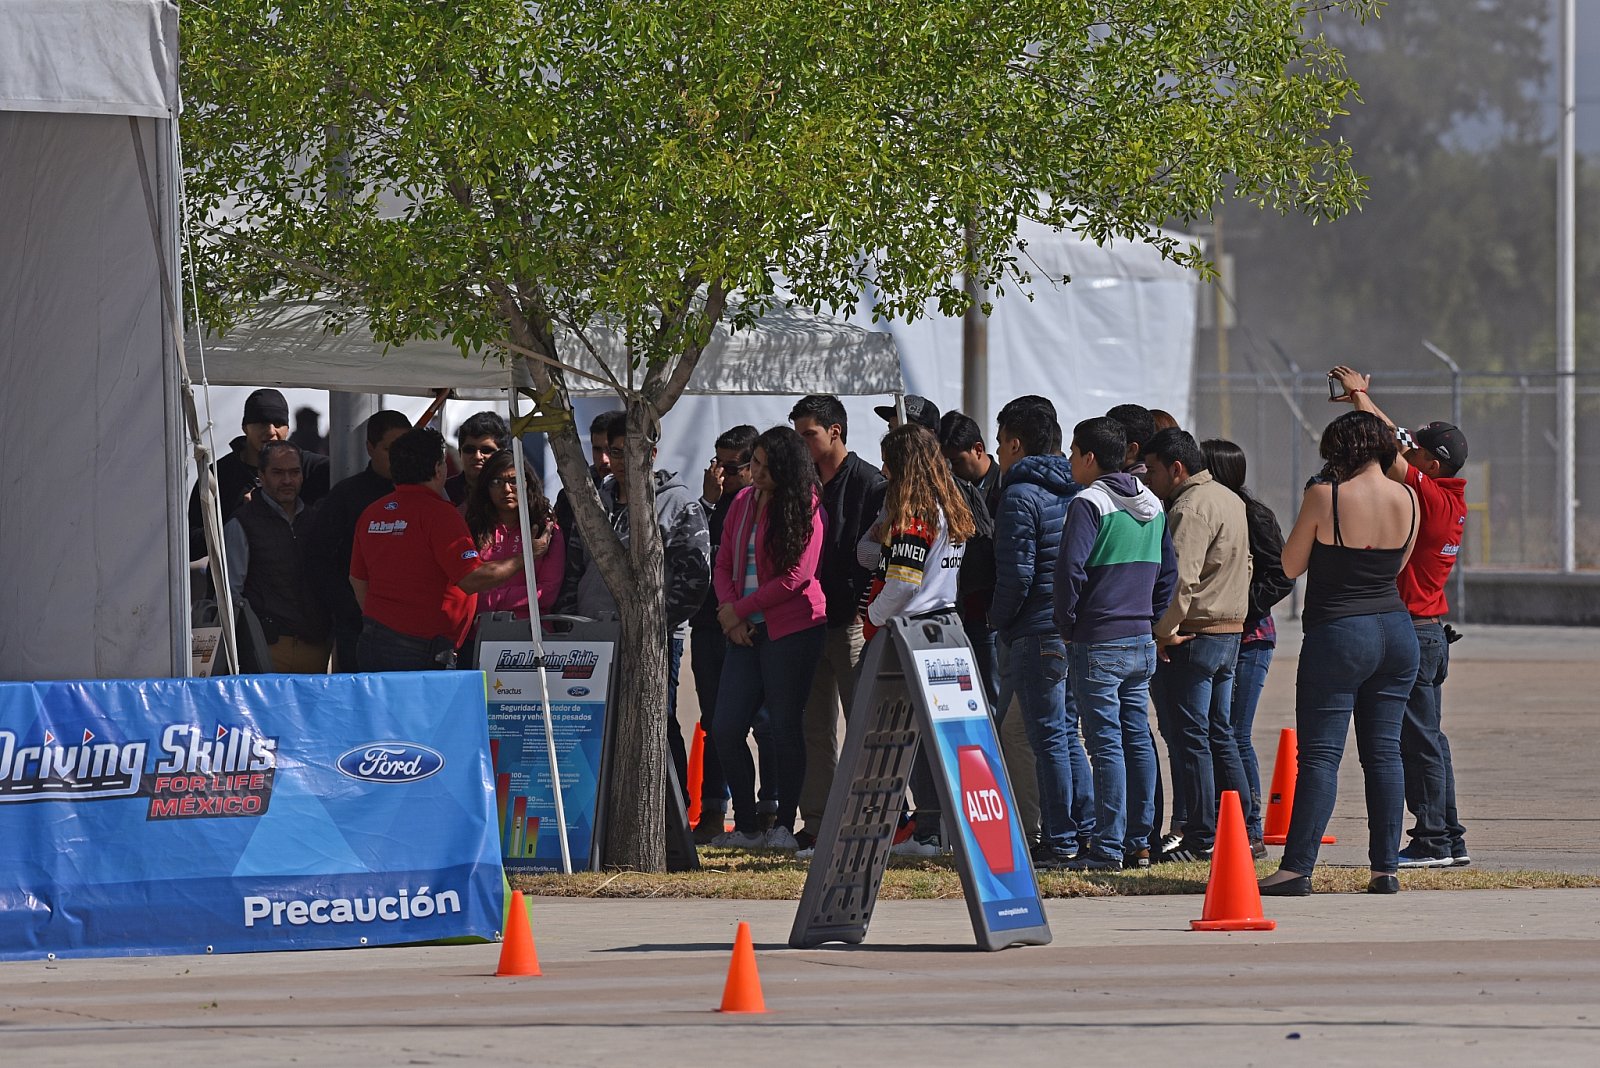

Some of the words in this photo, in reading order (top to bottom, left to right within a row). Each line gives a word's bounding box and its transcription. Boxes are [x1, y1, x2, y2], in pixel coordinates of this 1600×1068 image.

[568, 650, 599, 666] Skills
[500, 704, 536, 713] Seguridad
[572, 704, 581, 712] de
[158, 724, 276, 774] Skills
[359, 747, 422, 777] Ford
[155, 776, 207, 793] FOR
[212, 774, 265, 791] LIFE
[151, 793, 262, 817] MÉXICO
[966, 789, 1004, 823] ALTO
[244, 886, 461, 927] Precaución
